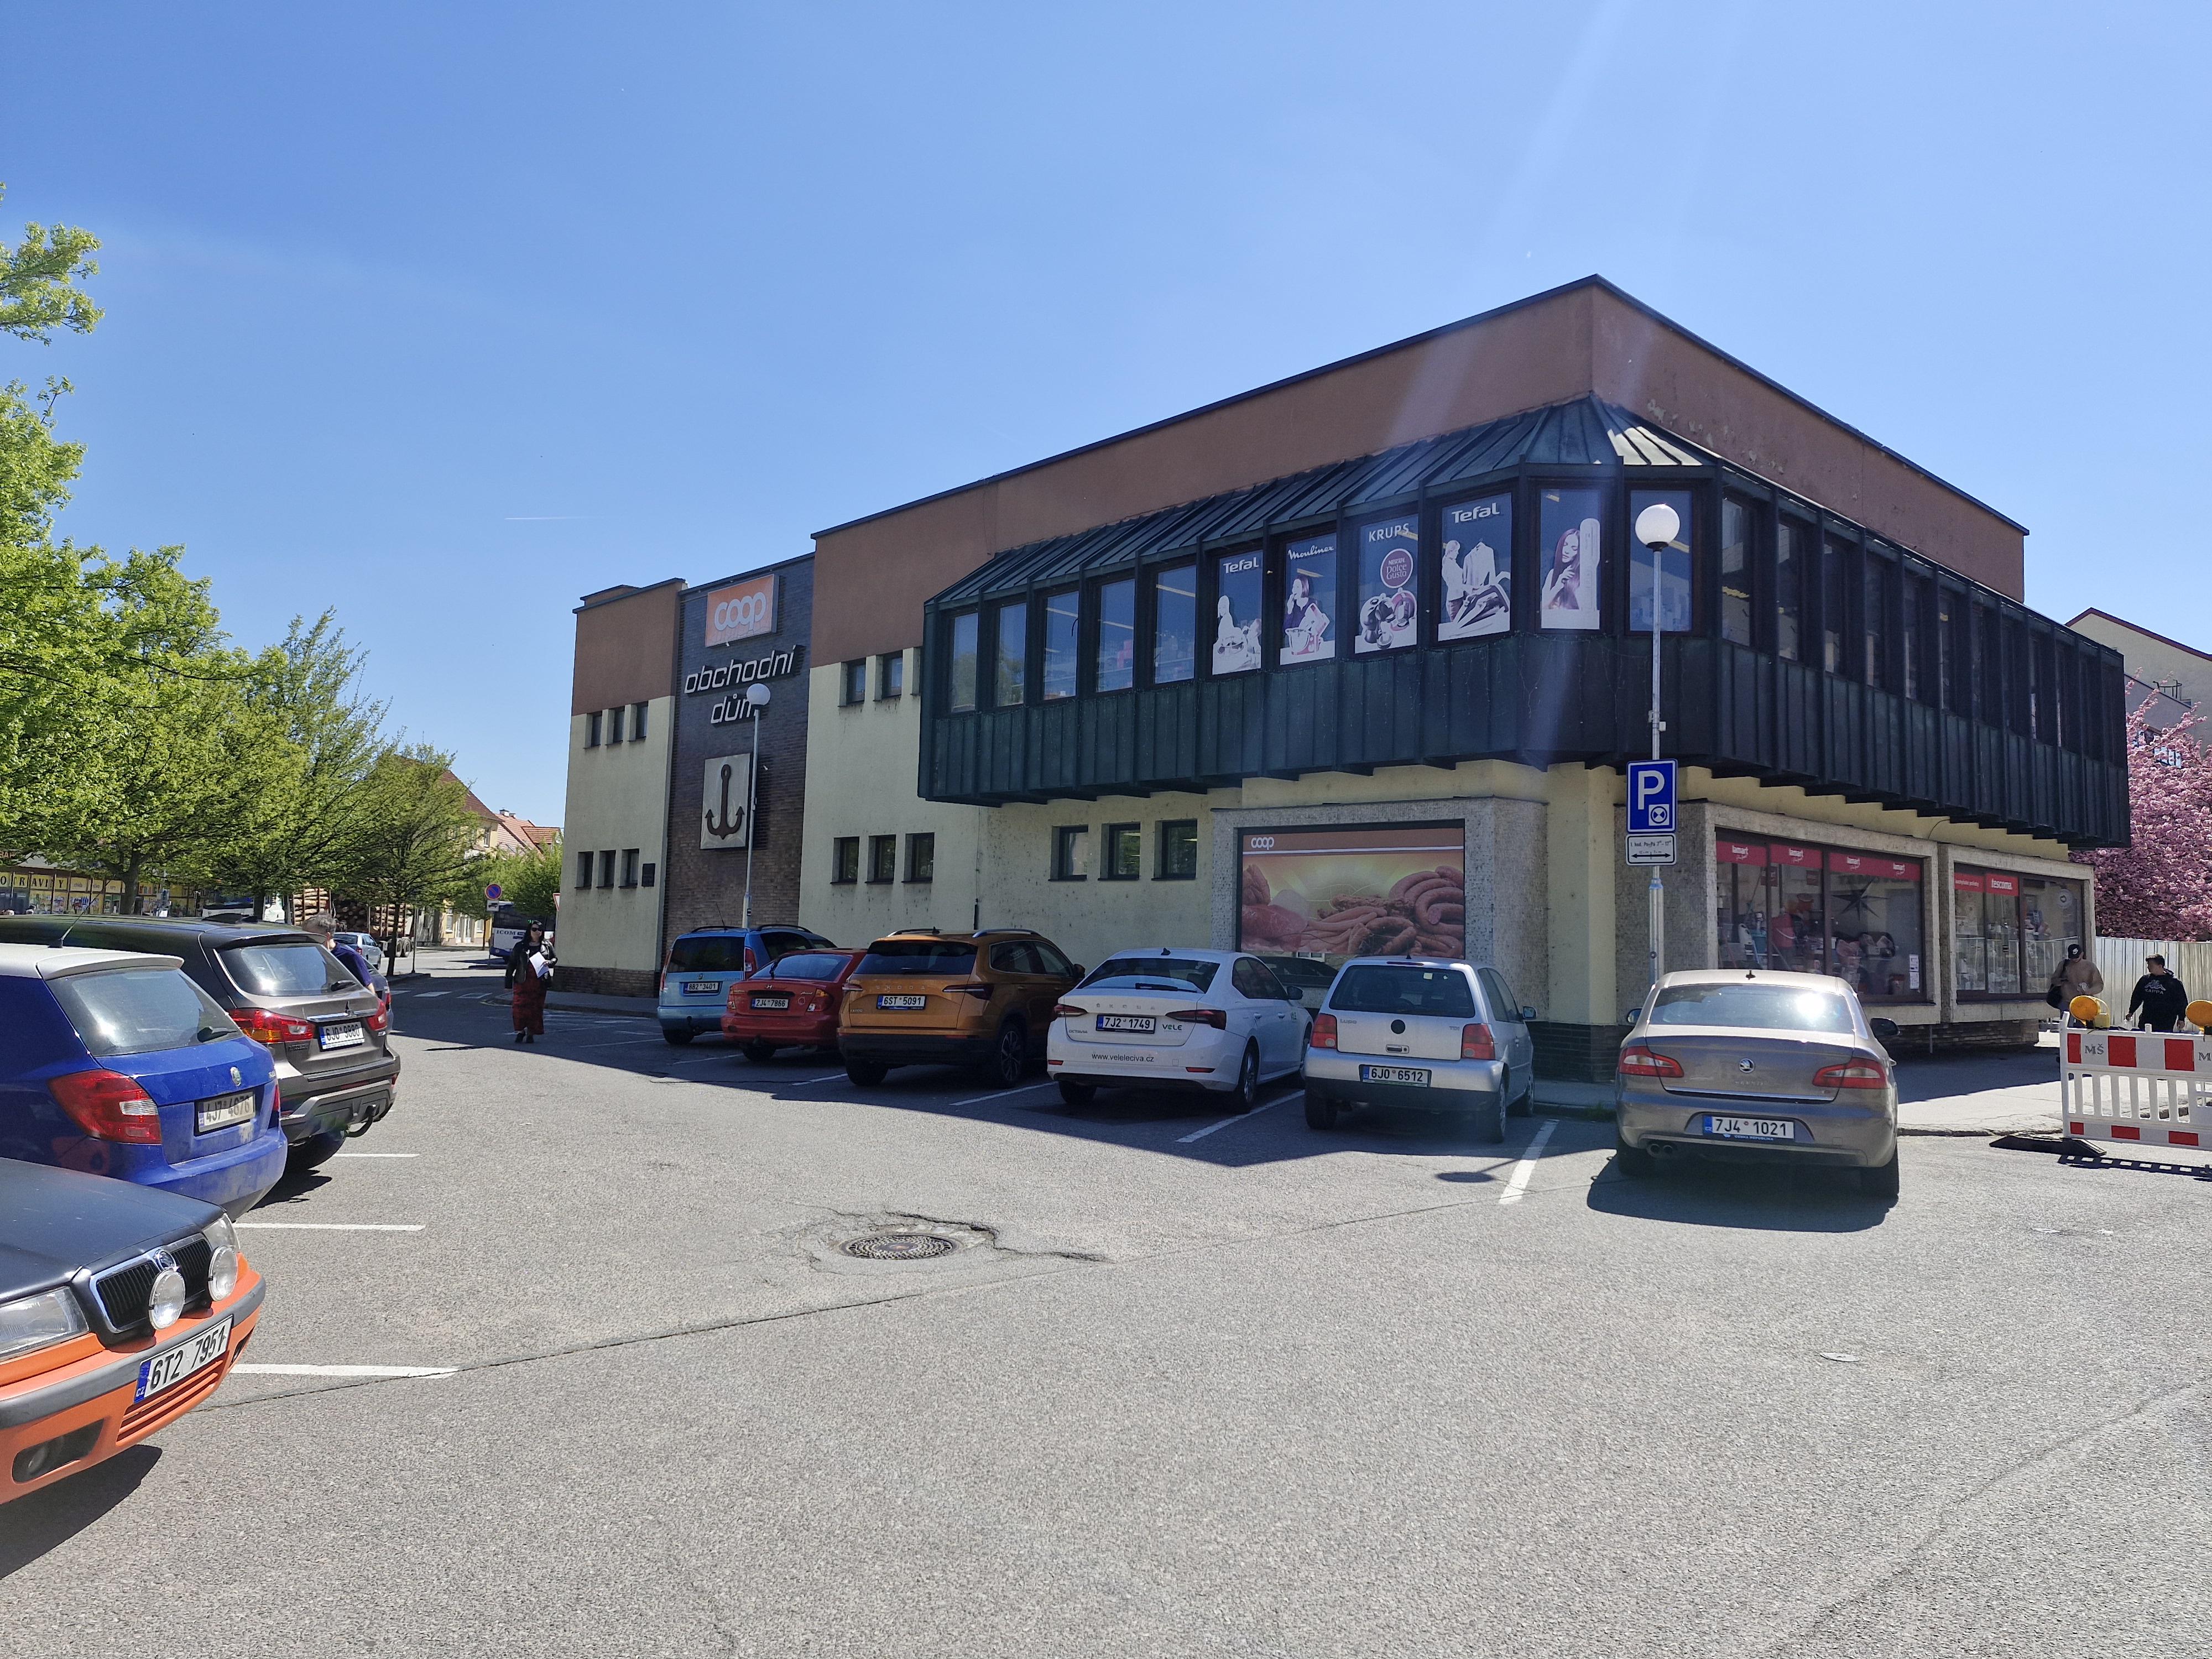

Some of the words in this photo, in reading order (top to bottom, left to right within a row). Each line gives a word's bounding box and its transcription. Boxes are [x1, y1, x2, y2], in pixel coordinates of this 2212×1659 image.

[1452, 502, 1500, 524] Tefal
[1369, 523, 1409, 542] KRUPS
[1287, 545, 1334, 560] Moulinex
[1223, 557, 1259, 573] Tefal
[1386, 564, 1407, 573] Dolce
[1386, 571, 1407, 580] Gusto
[714, 592, 766, 632] coop
[684, 644, 796, 693] obchodní
[1638, 770, 1665, 810] P
[1251, 837, 1275, 851] coop
[884, 997, 898, 1005] 6ST
[902, 997, 922, 1005] 5091
[1105, 1018, 1121, 1027] 7J2
[1129, 1019, 1150, 1029] 1749
[2085, 1044, 2104, 1055] MŠ
[1092, 1053, 1154, 1062] www.veleleciva.cz
[1371, 1068, 1390, 1079] 6J0
[1397, 1070, 1423, 1082] 6512
[206, 1100, 222, 1123] 4J7
[1715, 1119, 1741, 1133] 7J4
[1753, 1121, 1786, 1136] 1021
[150, 1349, 184, 1390] 6T2
[190, 1325, 226, 1370] 7951
[136, 1386, 145, 1397] CZ
